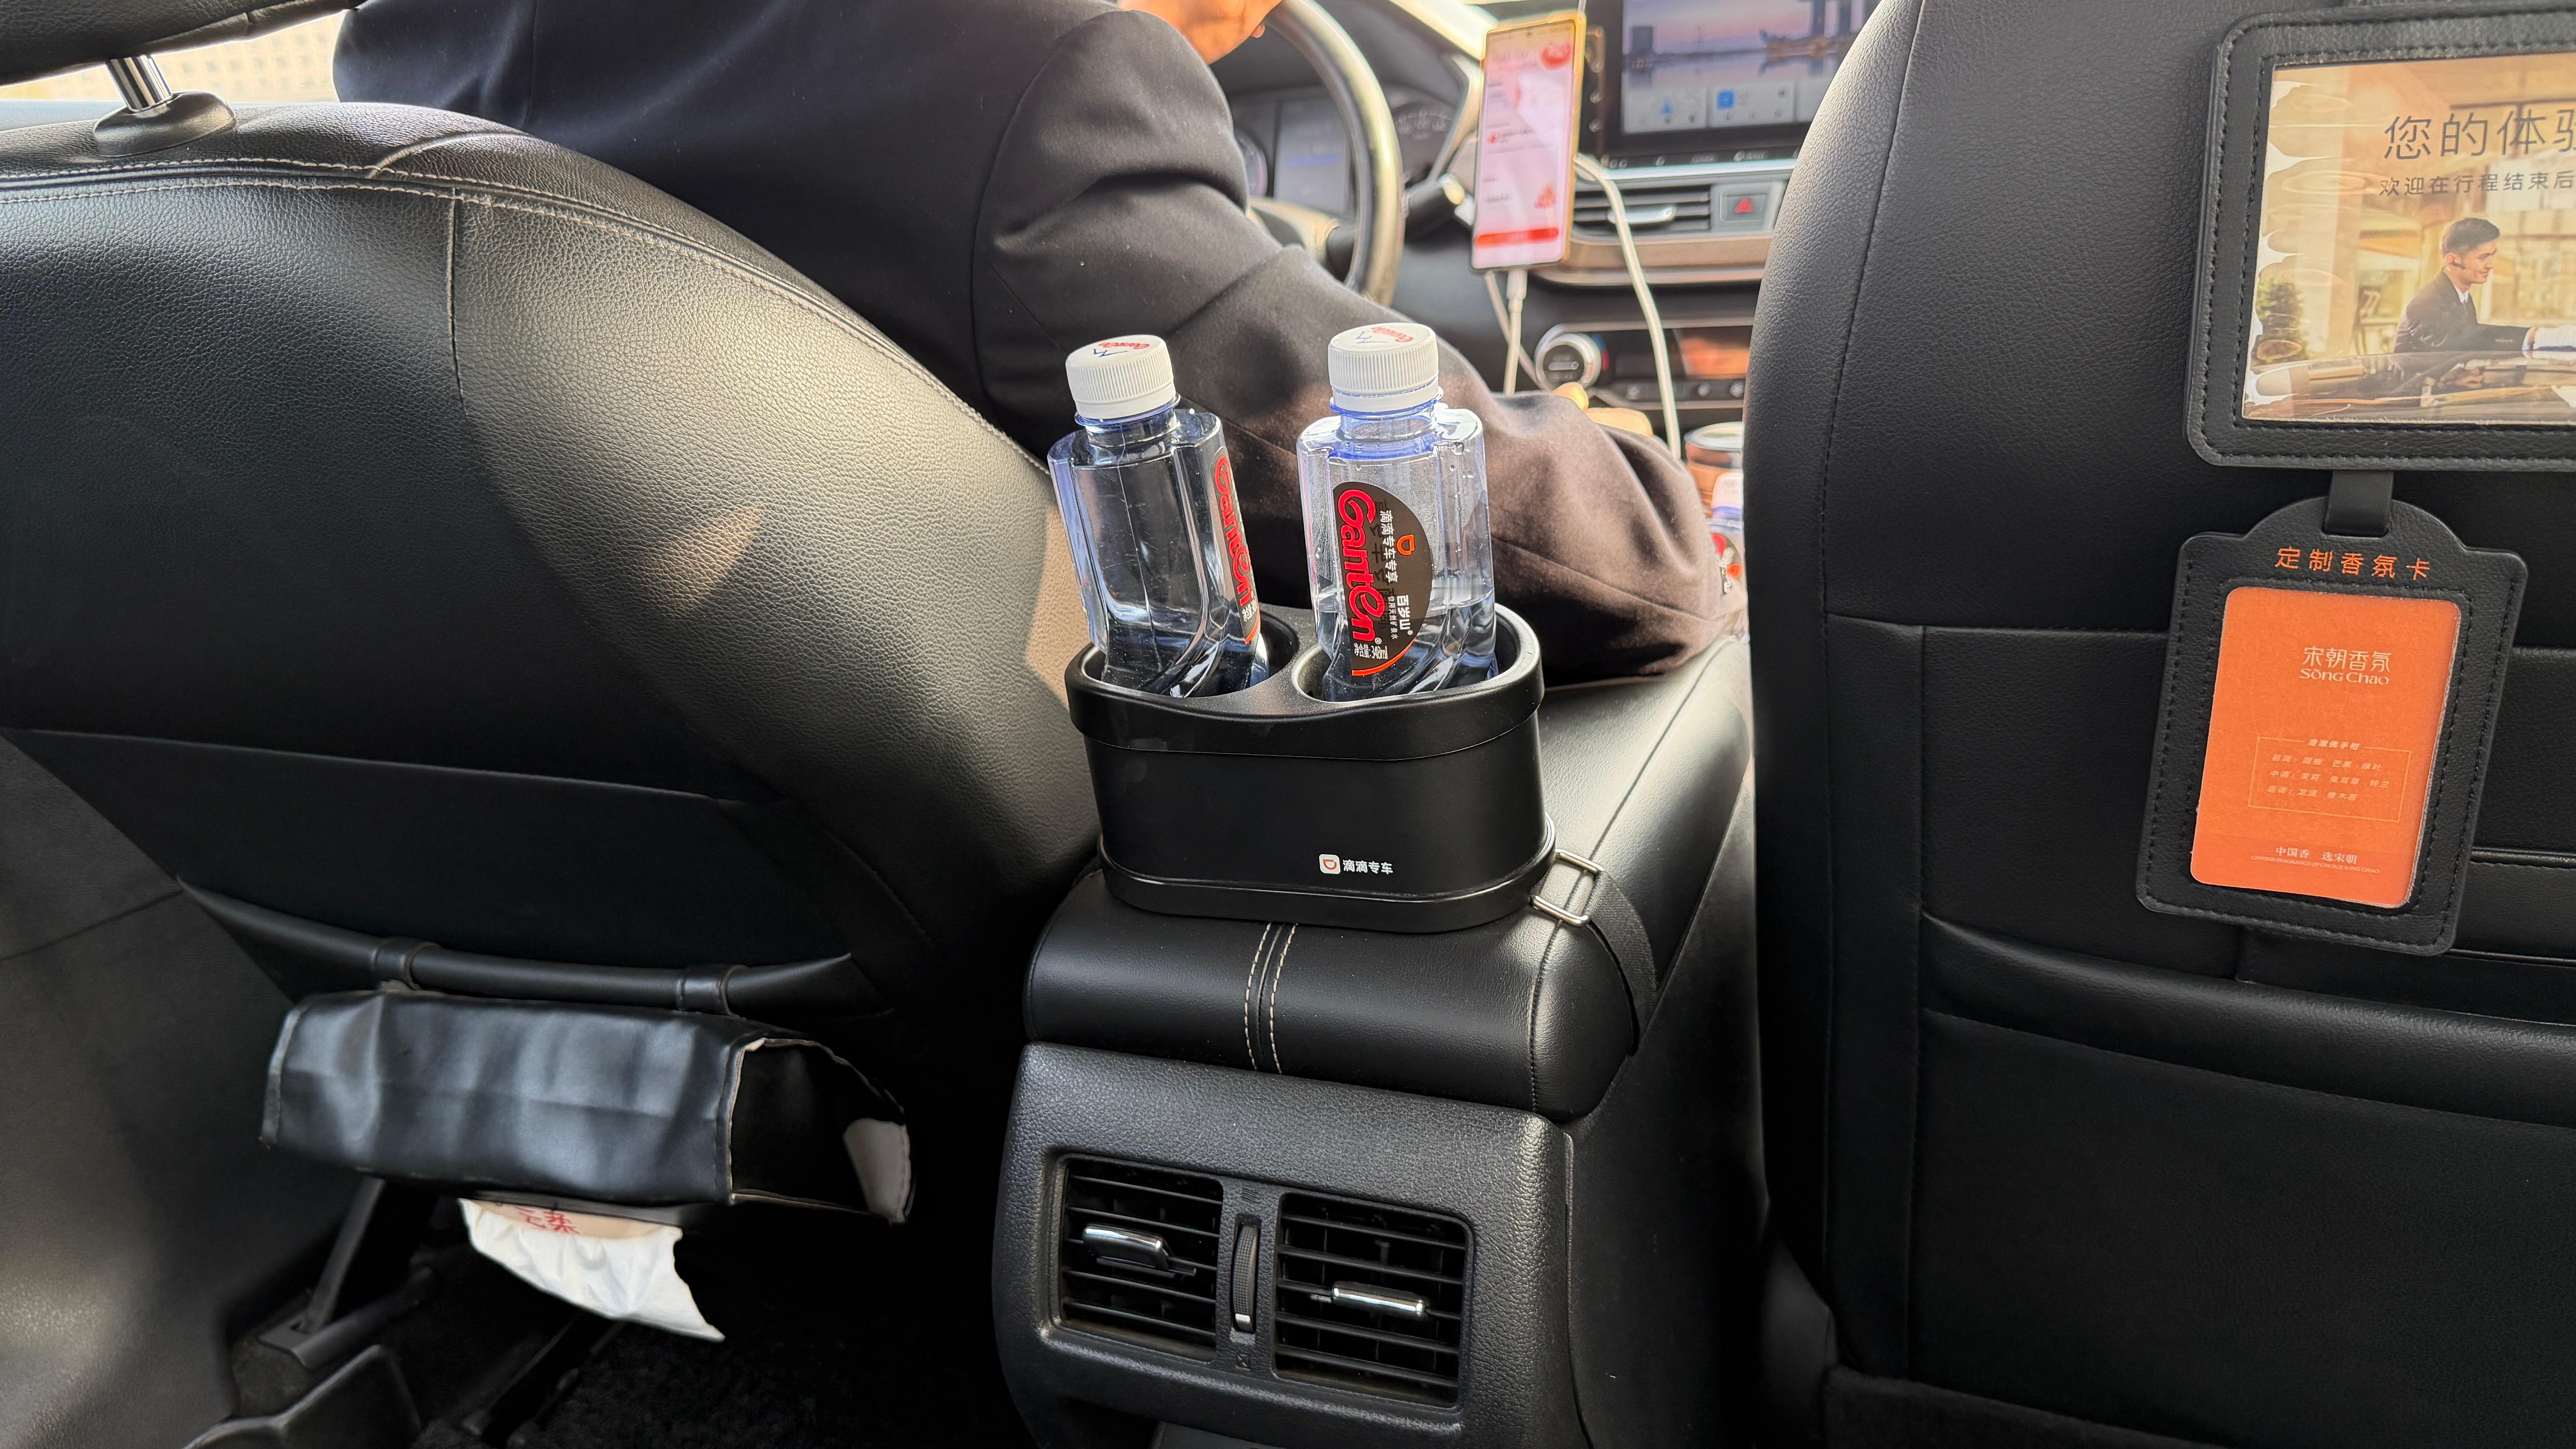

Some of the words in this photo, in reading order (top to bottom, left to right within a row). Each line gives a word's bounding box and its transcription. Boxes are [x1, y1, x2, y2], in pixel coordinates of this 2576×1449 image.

[2379, 170, 2574, 196] 欢迎在行程结束后
[1214, 455, 1252, 607] Ganten
[1380, 510, 1398, 583] 滴滴专车专享
[1338, 490, 1386, 642] Ganten
[2275, 546, 2431, 581] 定制香氛卡
[1388, 596, 1399, 639] 饮用天然矿泉水
[1396, 594, 1411, 630] 百岁山
[2301, 646, 2392, 673] 宋朝香氛
[2346, 672, 2389, 685] Chao
[1342, 859, 1394, 875] 滴滴专车
[2275, 846, 2310, 859] 中国香
[2321, 851, 2357, 864] 选宋朝
